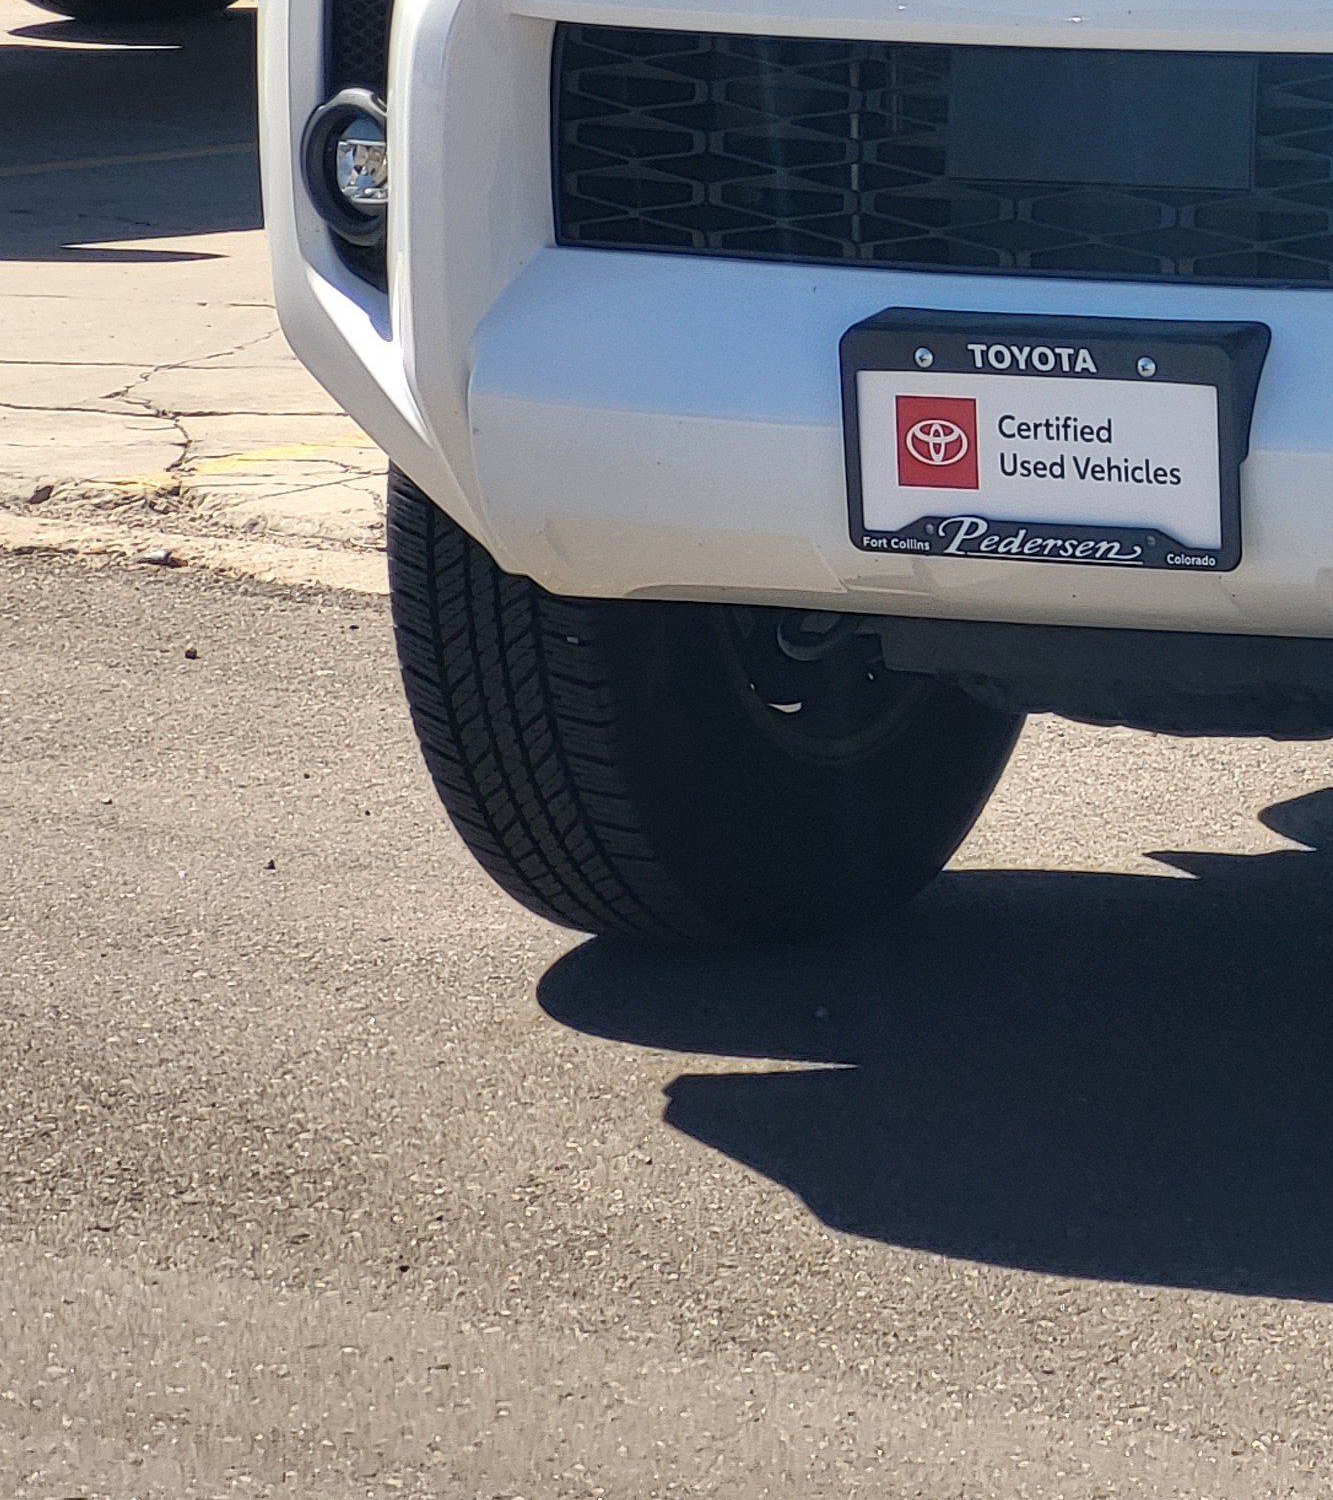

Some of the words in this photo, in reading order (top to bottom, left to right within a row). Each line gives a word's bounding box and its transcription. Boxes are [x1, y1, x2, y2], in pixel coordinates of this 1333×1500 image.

[967, 343, 1098, 374] TOYOTA
[998, 414, 1113, 444] Certified
[1000, 452, 1066, 480] Used
[1072, 455, 1182, 486] Vehicles
[862, 536, 888, 549] Fort
[890, 537, 931, 551] Collins
[938, 516, 1142, 560] Pedersen
[1166, 553, 1217, 567] Colorado
